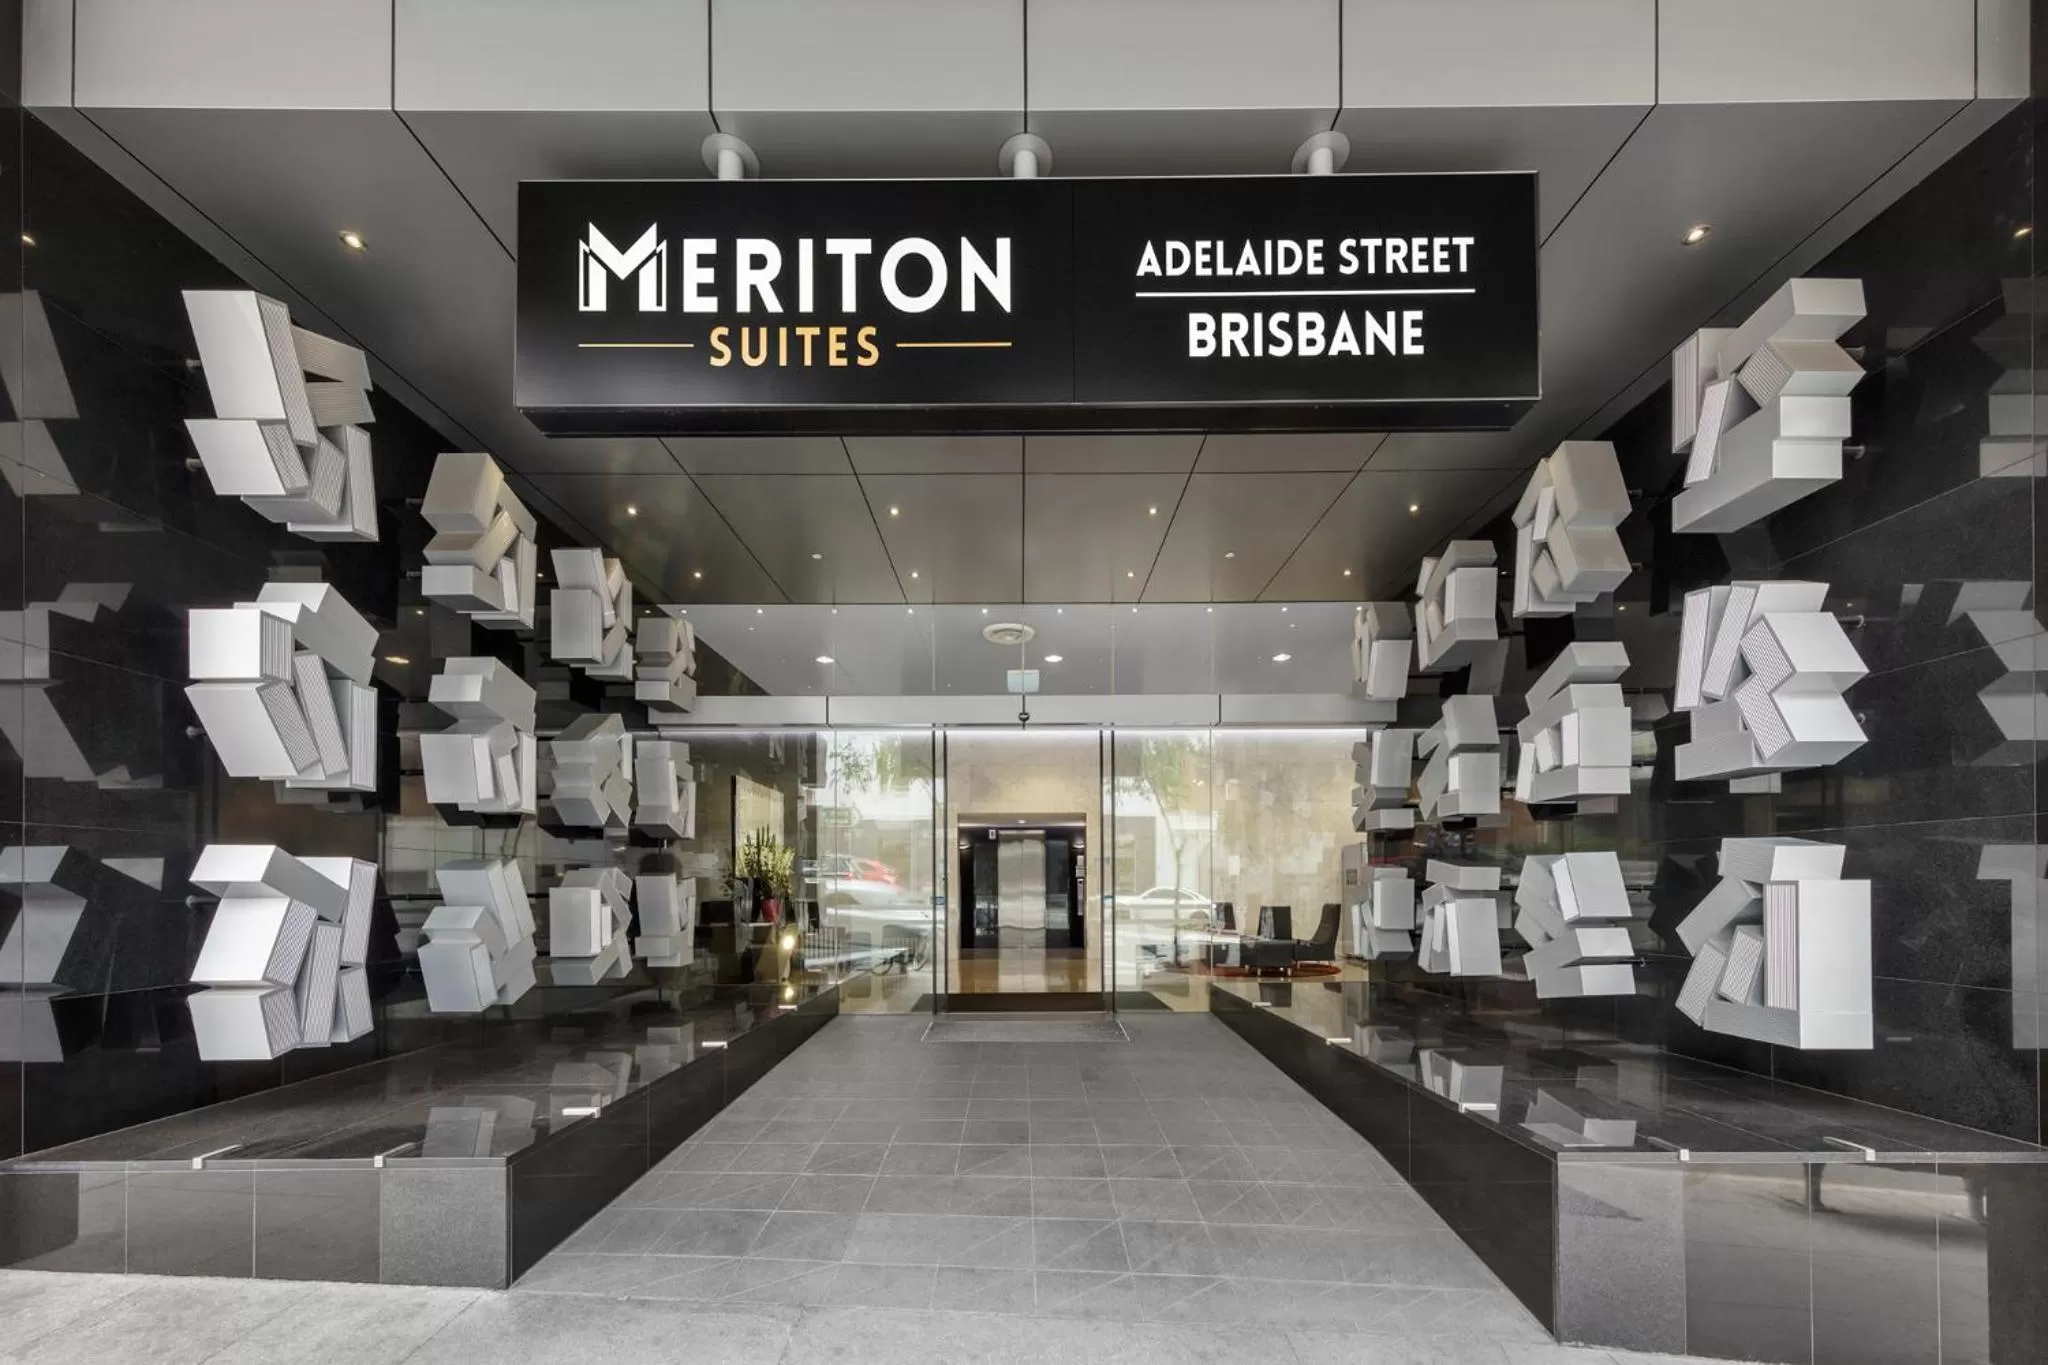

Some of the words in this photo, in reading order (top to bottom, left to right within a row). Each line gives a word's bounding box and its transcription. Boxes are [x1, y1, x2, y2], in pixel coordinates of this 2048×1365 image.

[577, 222, 1012, 314] MERITON
[1136, 239, 1325, 277] ADELAIDE
[1339, 236, 1475, 275] STREET
[709, 326, 880, 367] SUITES
[1188, 309, 1425, 358] BRISBANE
